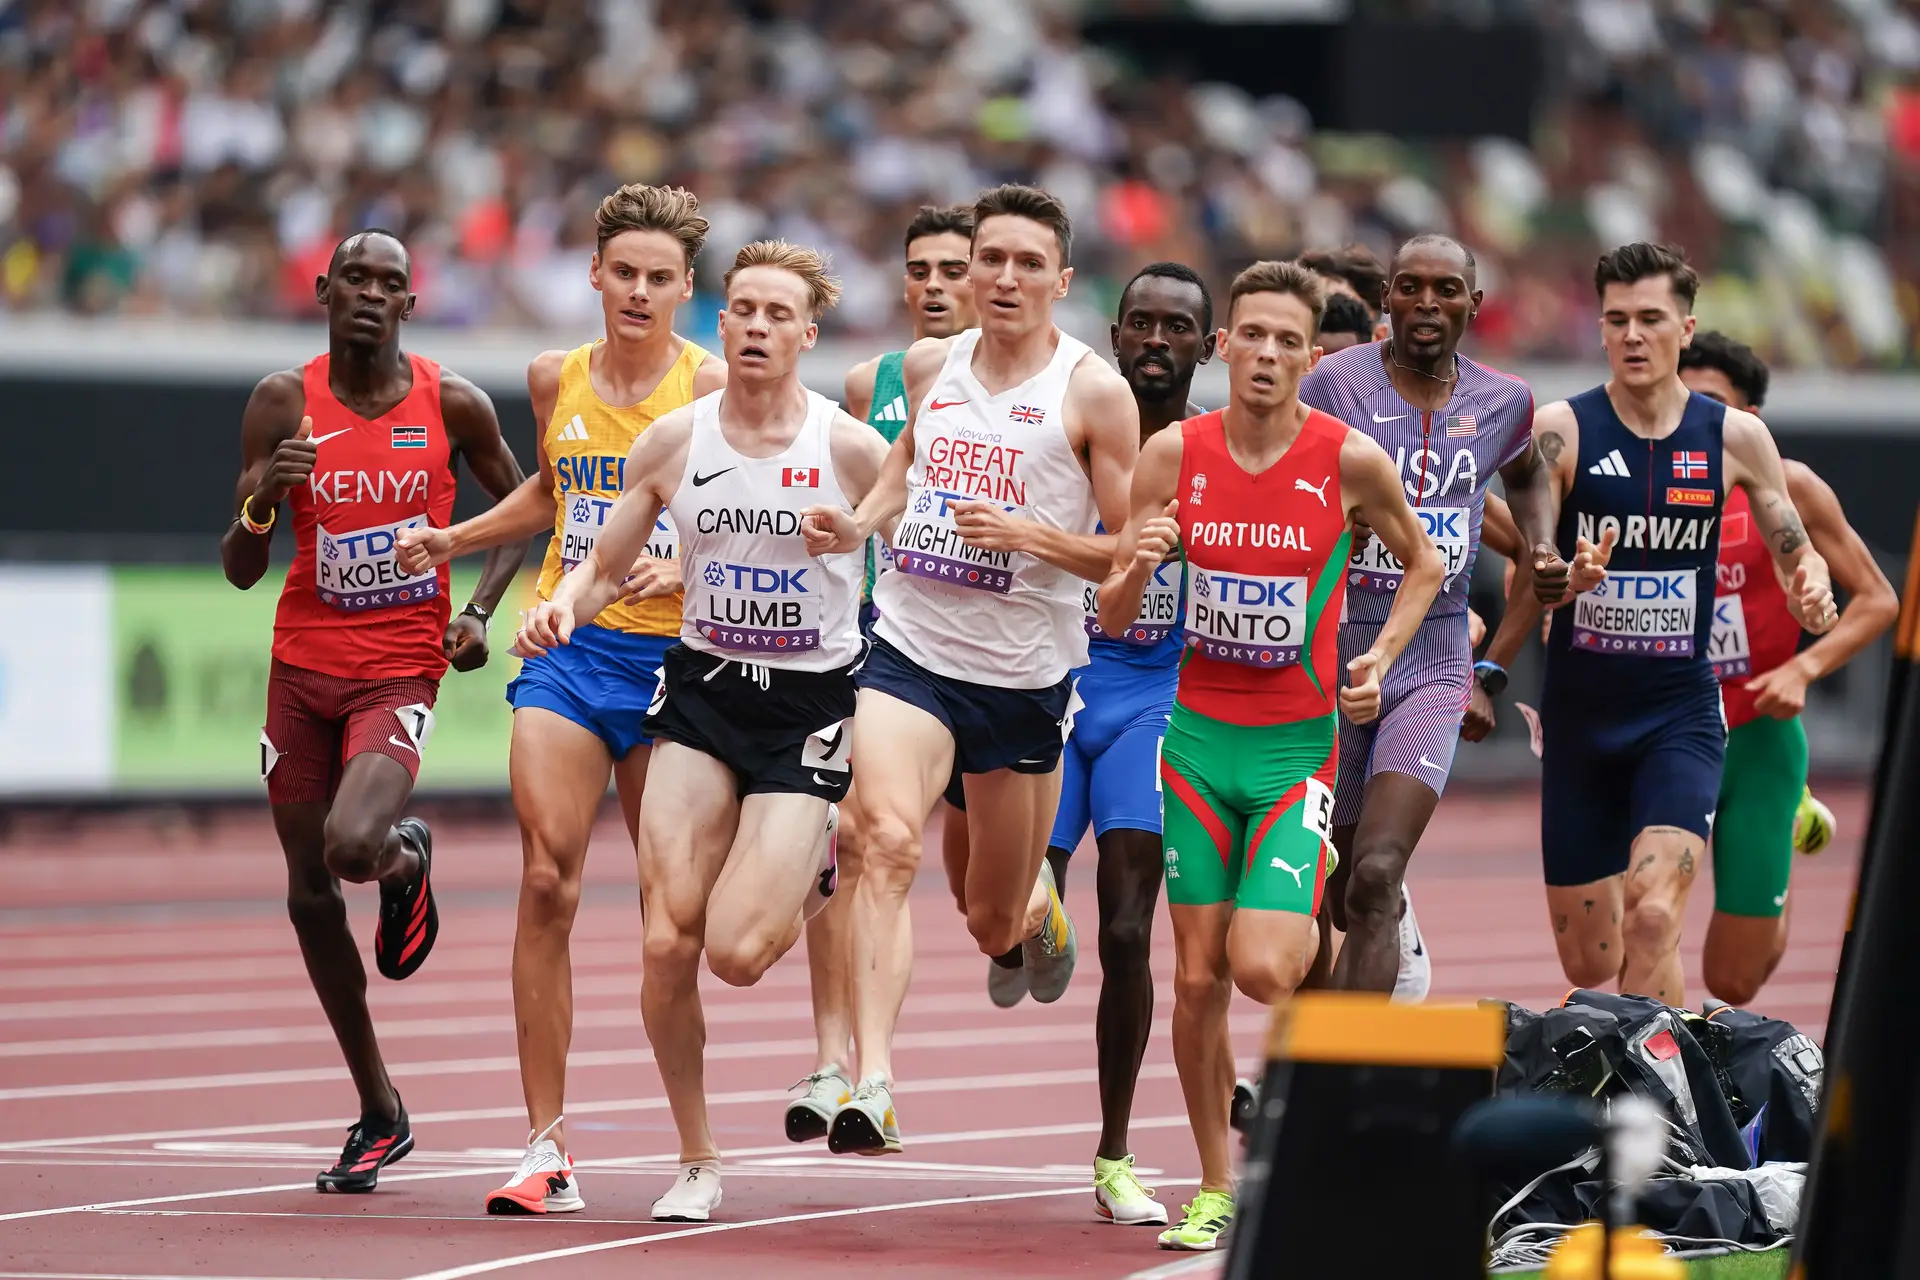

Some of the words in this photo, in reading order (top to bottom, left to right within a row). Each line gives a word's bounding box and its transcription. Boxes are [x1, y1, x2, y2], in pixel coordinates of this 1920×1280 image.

[952, 426, 1003, 443] Novuna
[929, 437, 1024, 476] GREAT
[310, 470, 428, 505] KENYA
[923, 465, 1026, 507] BRITAIN
[1684, 492, 1711, 502] EXTRA
[337, 521, 418, 560] TD
[1191, 522, 1311, 551] PORTUGAL
[1417, 512, 1460, 538] DK
[1578, 511, 1716, 550] NORWAY
[321, 561, 335, 588] P.
[726, 563, 809, 594] TDK
[1608, 576, 1686, 599] TDK
[1211, 575, 1296, 607] TDK
[710, 594, 802, 627] LUMB
[1195, 603, 1291, 642] PINTO
[1579, 600, 1691, 632] INGEBRIGTSEN
[1318, 792, 1329, 832] 5
